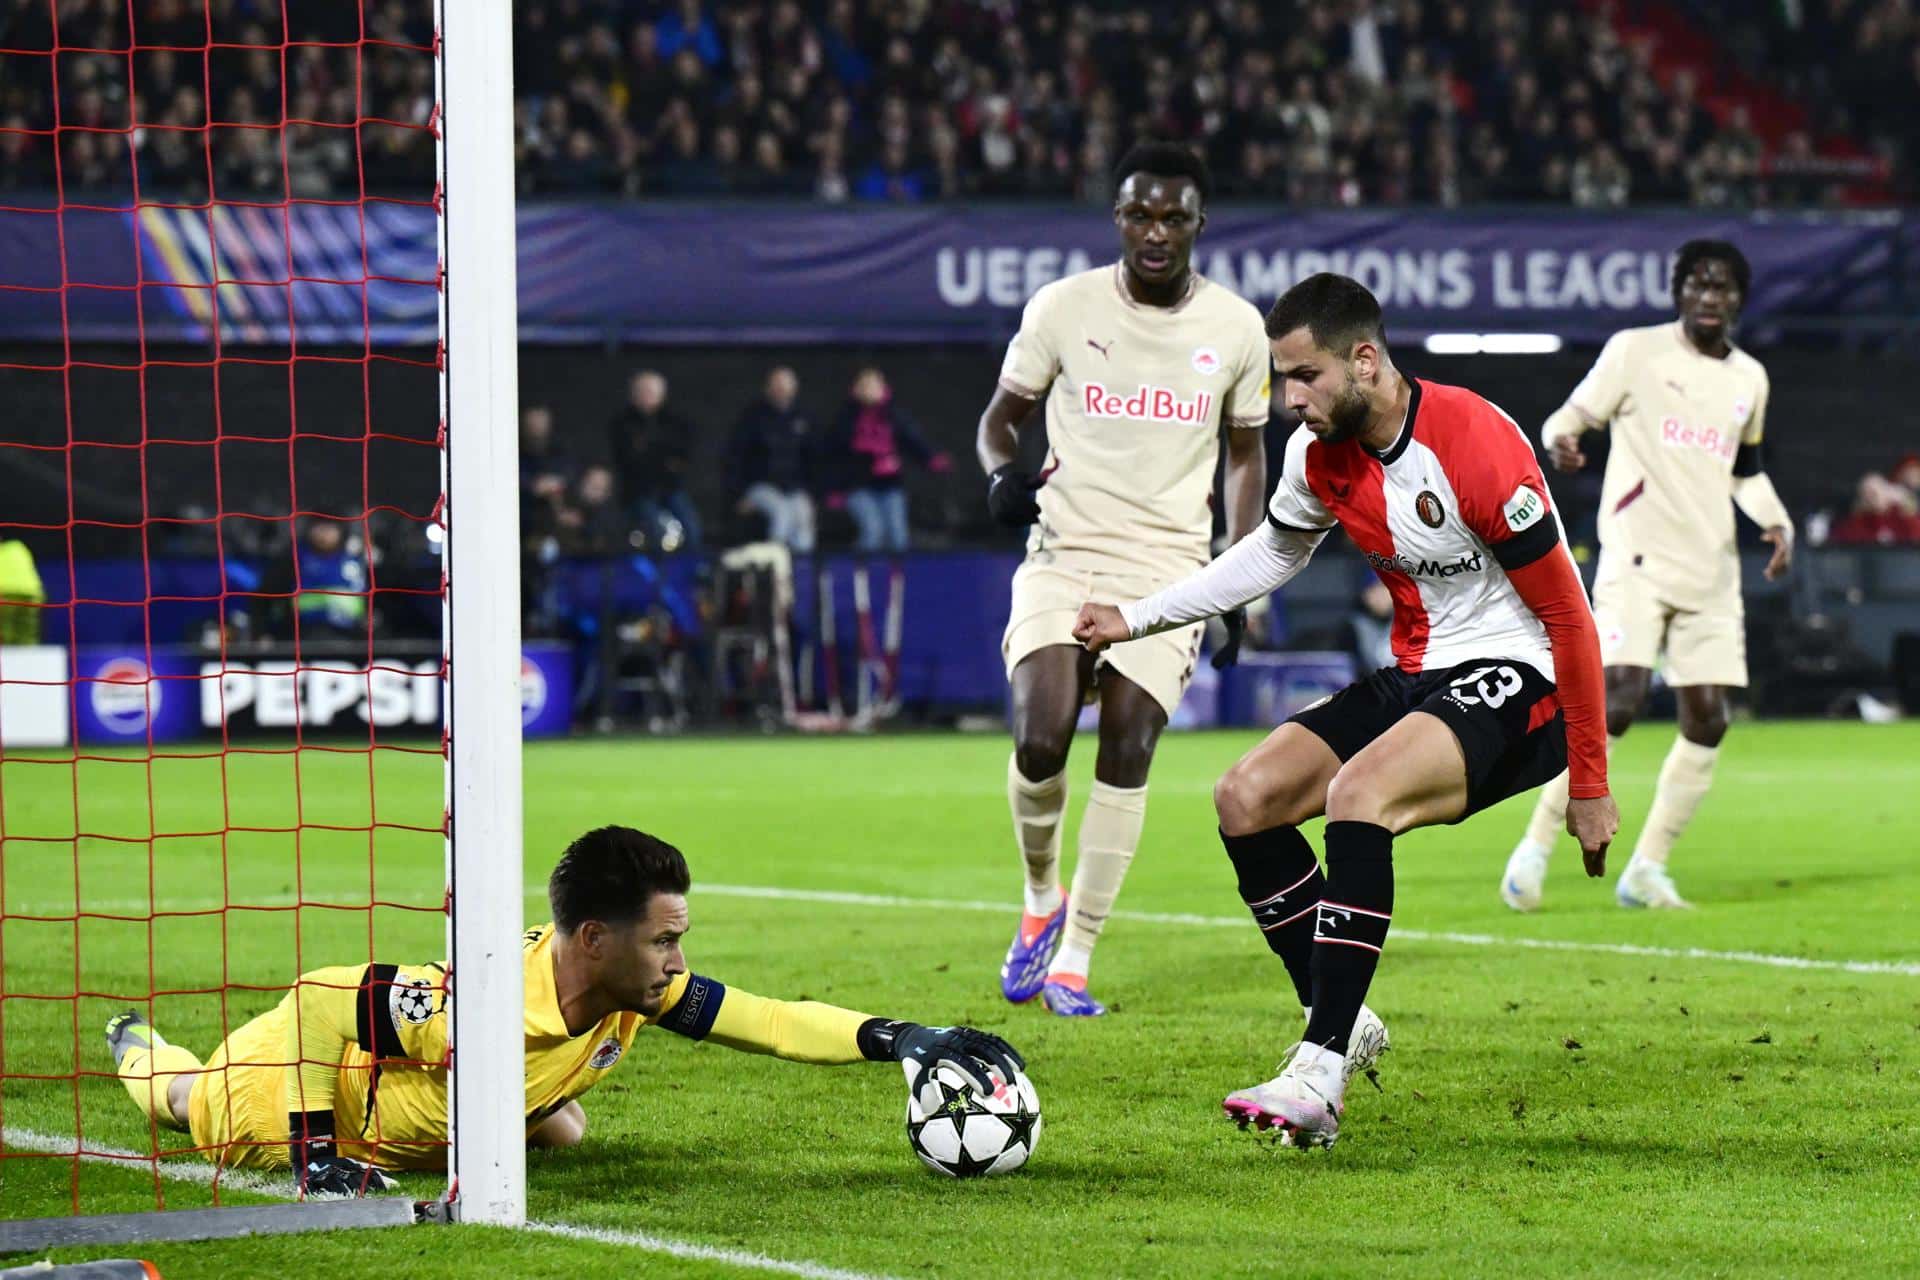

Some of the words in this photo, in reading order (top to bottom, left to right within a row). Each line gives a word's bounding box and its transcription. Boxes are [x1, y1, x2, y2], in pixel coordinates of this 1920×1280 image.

[1190, 248, 1474, 306] AMPONS
[1492, 250, 1677, 307] LEAGU
[1509, 492, 1538, 526] TOTO
[1416, 551, 1482, 577] Markt
[201, 661, 440, 727] PEPSI
[681, 983, 705, 1025] RESPECT
